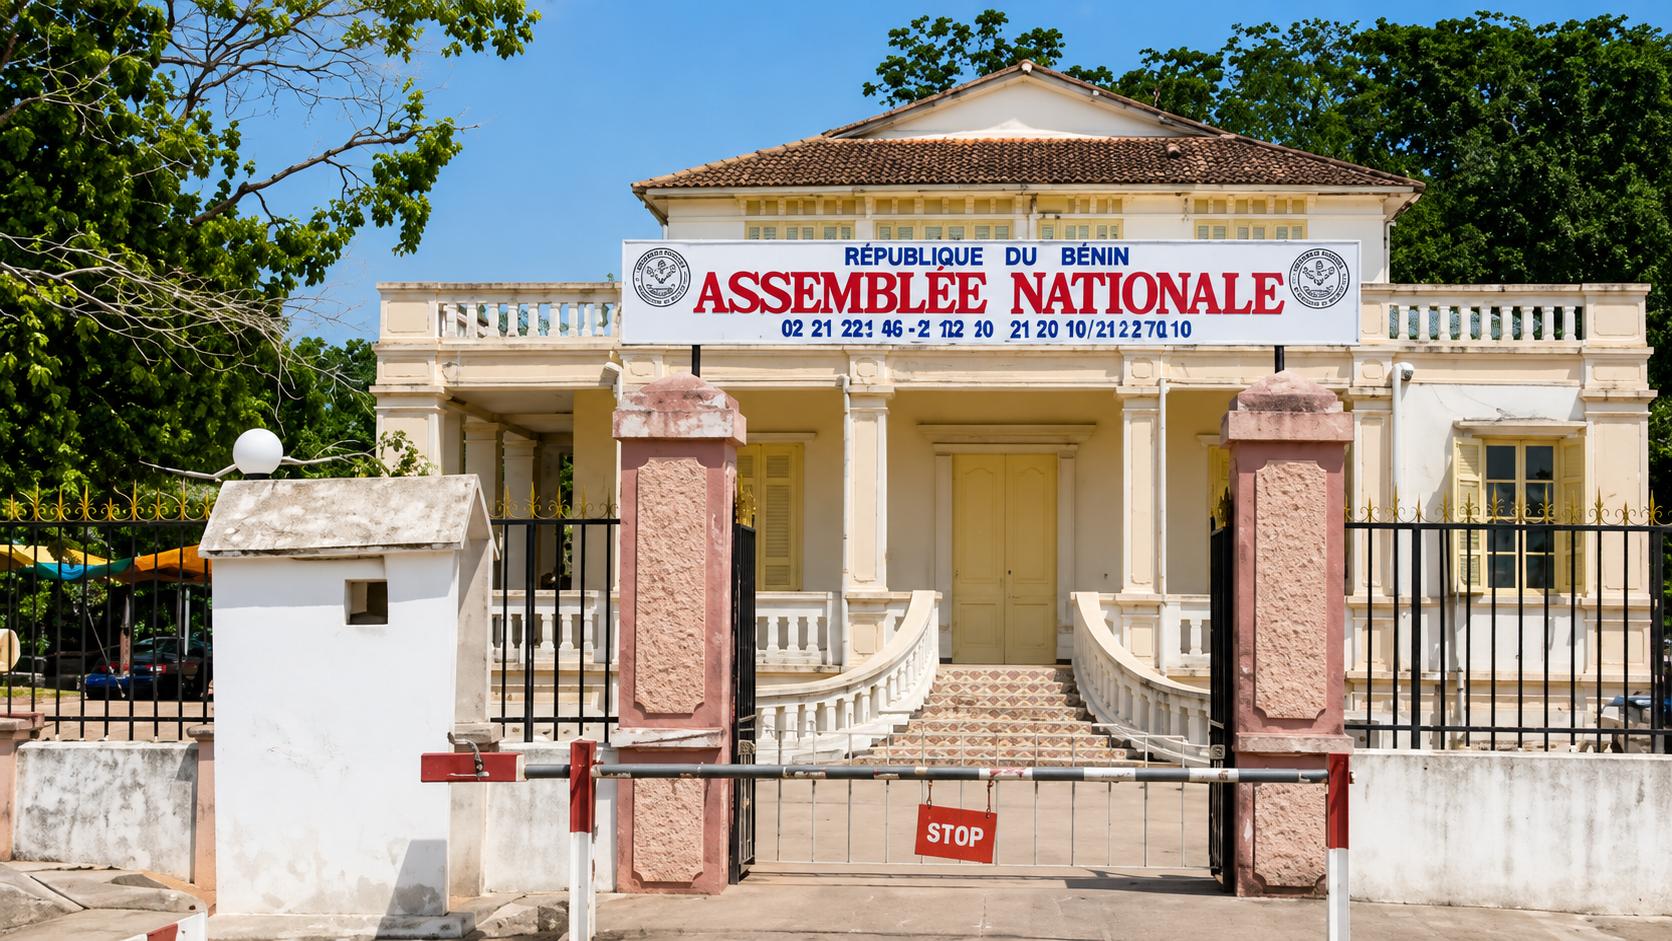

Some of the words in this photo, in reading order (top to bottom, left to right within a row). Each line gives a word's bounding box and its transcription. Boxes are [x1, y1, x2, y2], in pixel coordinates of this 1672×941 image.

[844, 242, 984, 267] RÉPUBLIQUE
[1005, 246, 1037, 267] DU
[1061, 241, 1129, 266] BÉNIN
[693, 265, 988, 314] ASSEMBLÉE
[1011, 271, 1285, 315] NATIONALE
[781, 318, 804, 338] 02
[811, 319, 832, 338] 21
[1009, 319, 1030, 339] 21
[1036, 319, 1059, 339] 20
[926, 822, 984, 848] STOP
